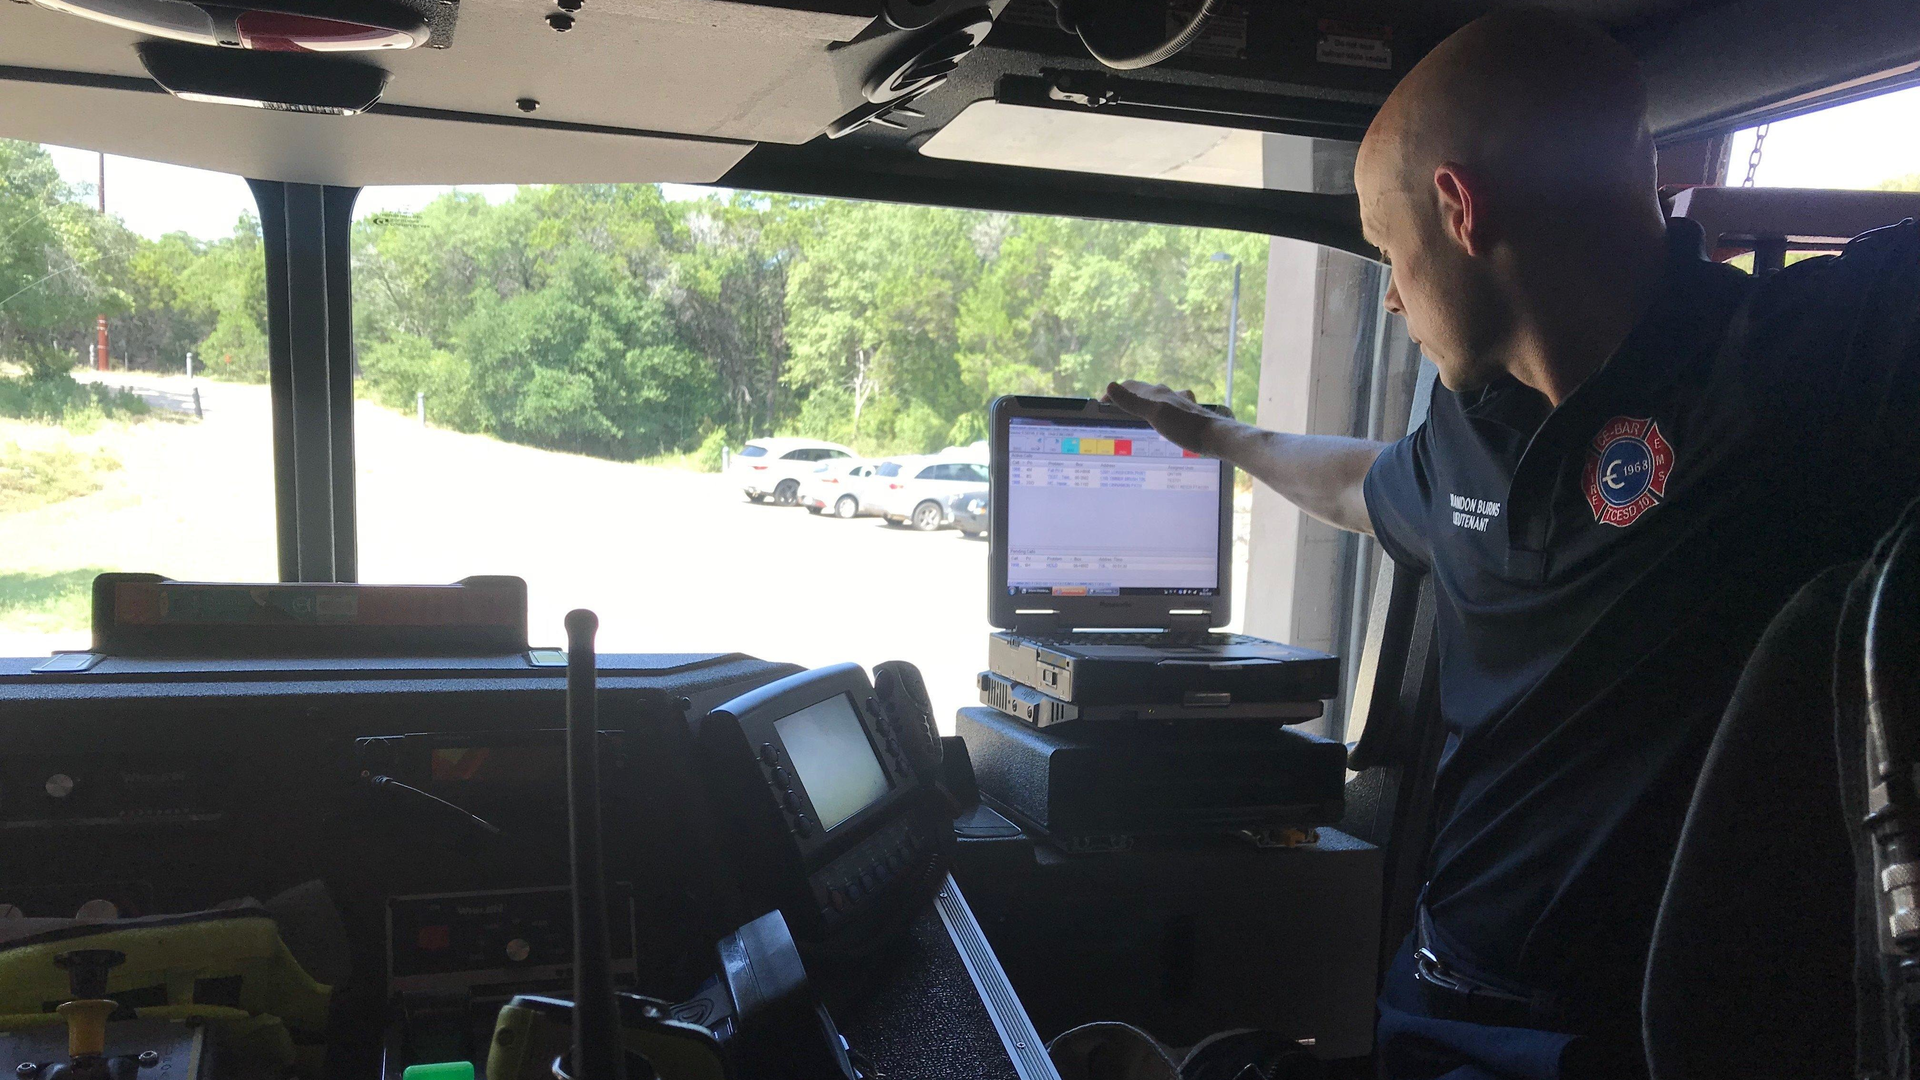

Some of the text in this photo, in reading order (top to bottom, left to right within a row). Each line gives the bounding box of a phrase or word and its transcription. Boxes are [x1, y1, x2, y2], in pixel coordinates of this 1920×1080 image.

[1597, 421, 1641, 446] CE-BAR
[1623, 459, 1649, 477] 1968
[1449, 492, 1501, 517] ANDON BURNS
[1606, 496, 1650, 521] TCESD 10
